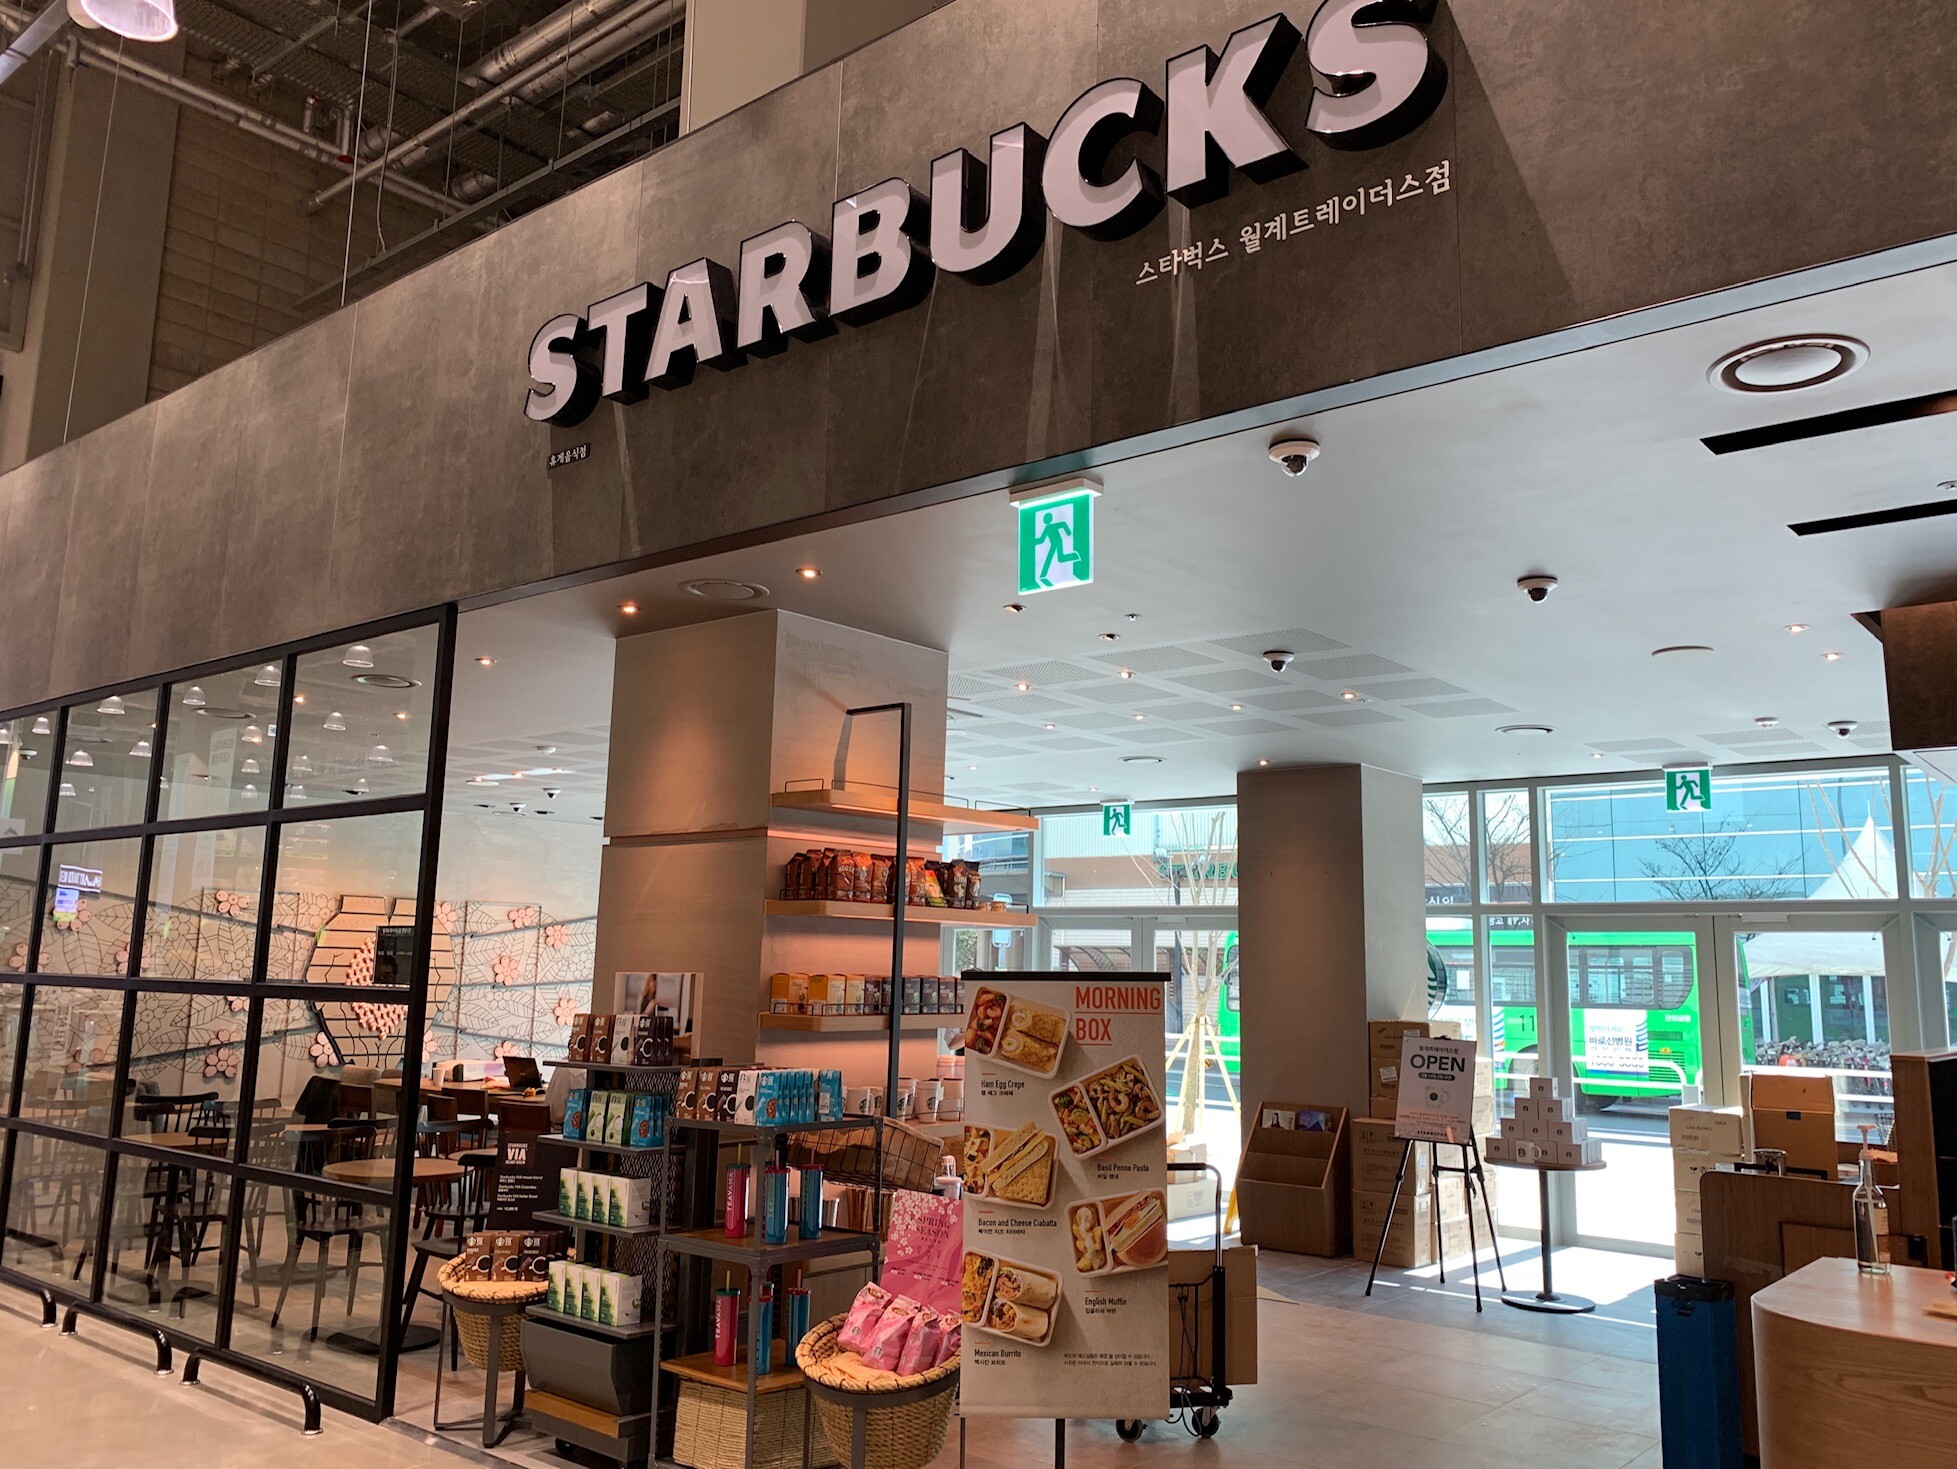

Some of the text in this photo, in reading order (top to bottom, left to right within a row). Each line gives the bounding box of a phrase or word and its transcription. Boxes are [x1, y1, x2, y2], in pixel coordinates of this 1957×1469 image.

[524, 0, 1447, 424] STARBUCKS
[1136, 159, 1451, 285] 스타벅스 월계트레이더스점
[1075, 986, 1162, 1010] MORNING
[1075, 1018, 1112, 1041] BOX
[1589, 1036, 1633, 1046] 바로선병원
[1410, 1054, 1466, 1072] OPEN
[981, 1080, 1025, 1090] Ham Egg Crepe
[507, 1148, 526, 1160] VIA
[918, 1216, 950, 1229] SPRING
[978, 1218, 1058, 1227] Bacon and Cheese Ciabatta
[916, 1226, 949, 1239] SEASON
[1085, 1297, 1128, 1307] English Muffin
[974, 1349, 1022, 1358] Mexican Burrito
